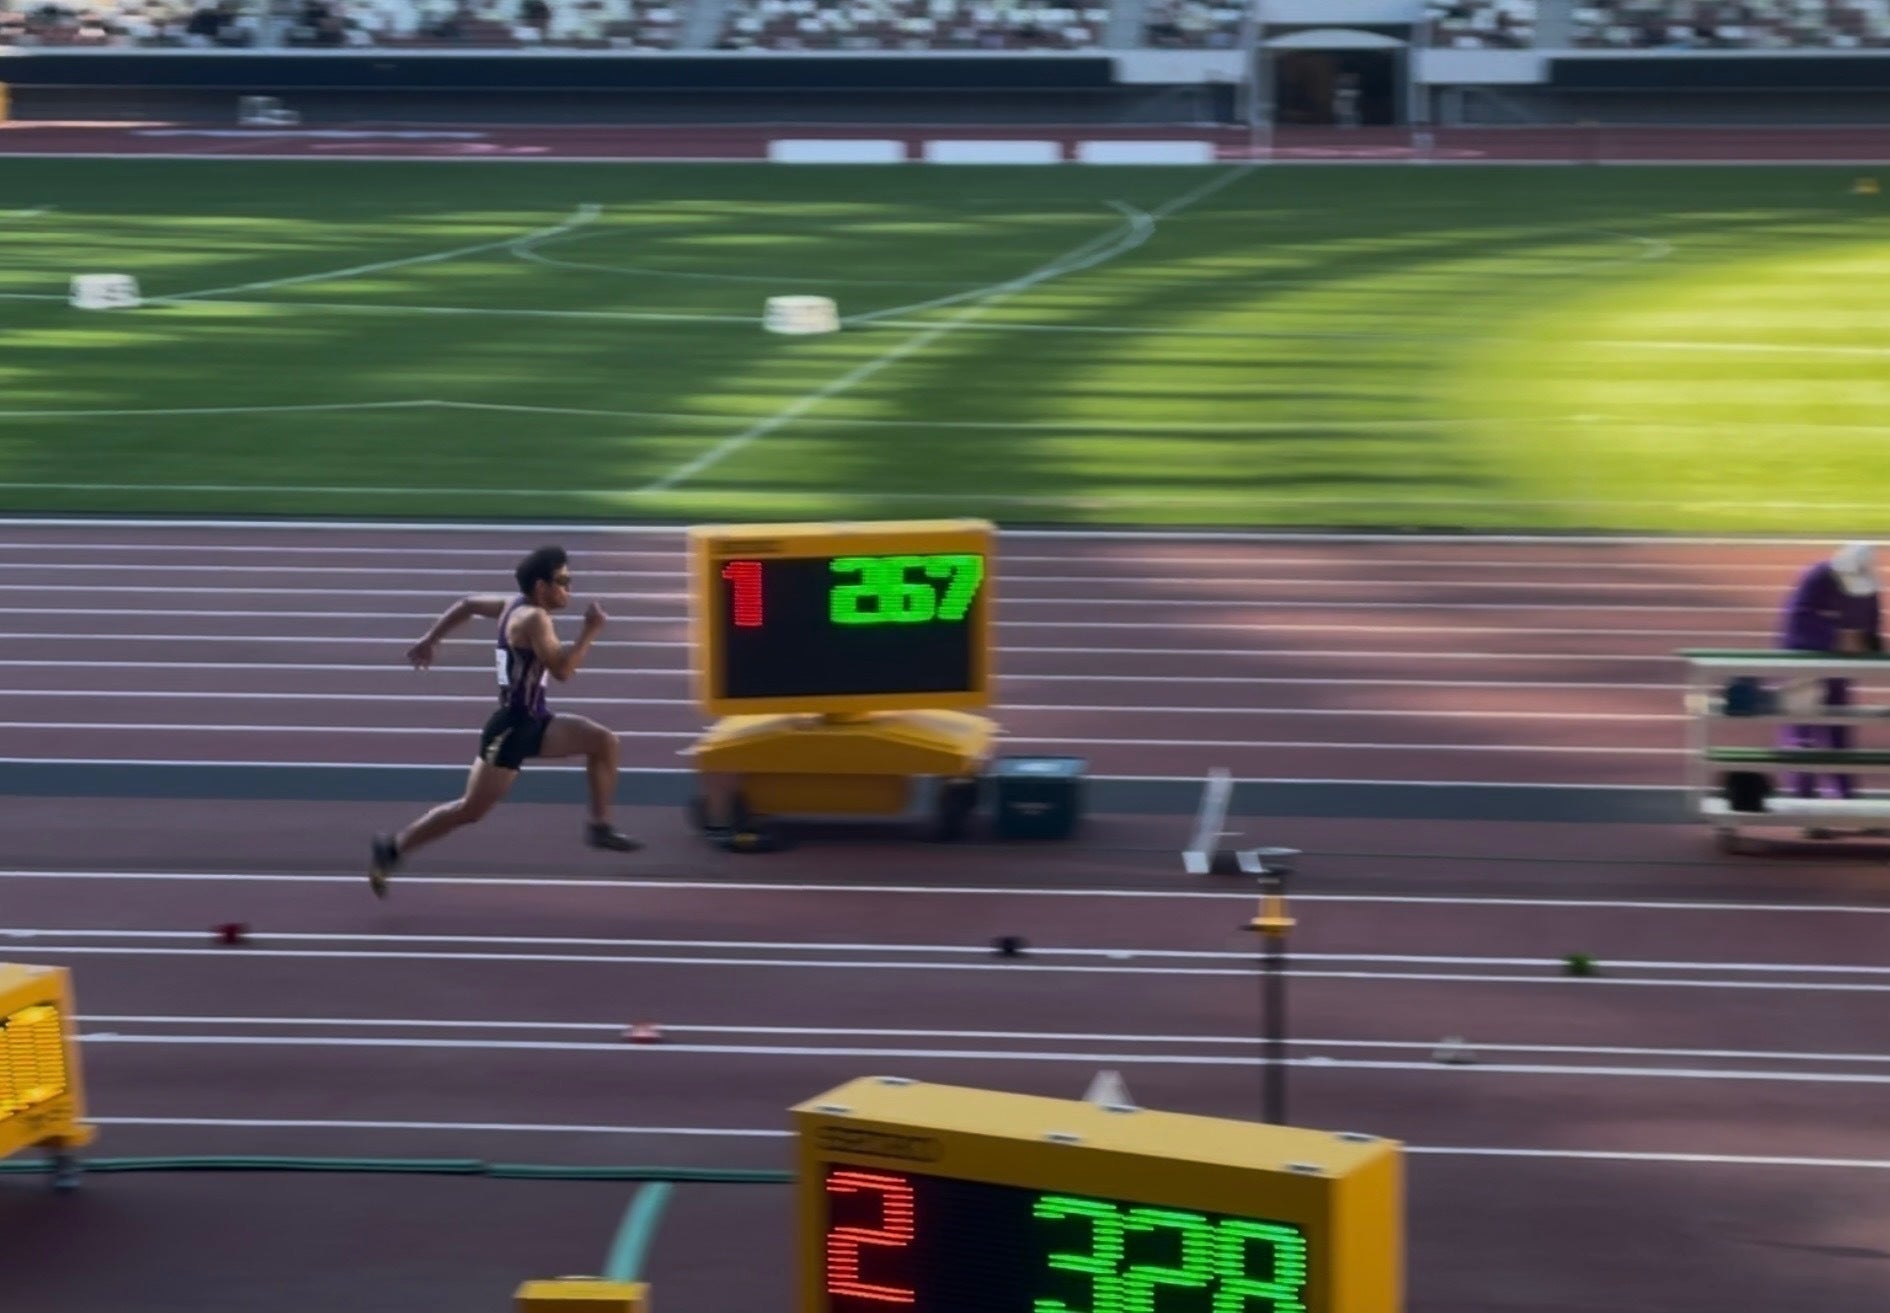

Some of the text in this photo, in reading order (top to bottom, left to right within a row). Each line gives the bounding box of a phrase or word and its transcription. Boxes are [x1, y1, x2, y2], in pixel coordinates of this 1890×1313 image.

[722, 554, 983, 626] 1 267
[826, 1171, 1307, 1313] 2 328
